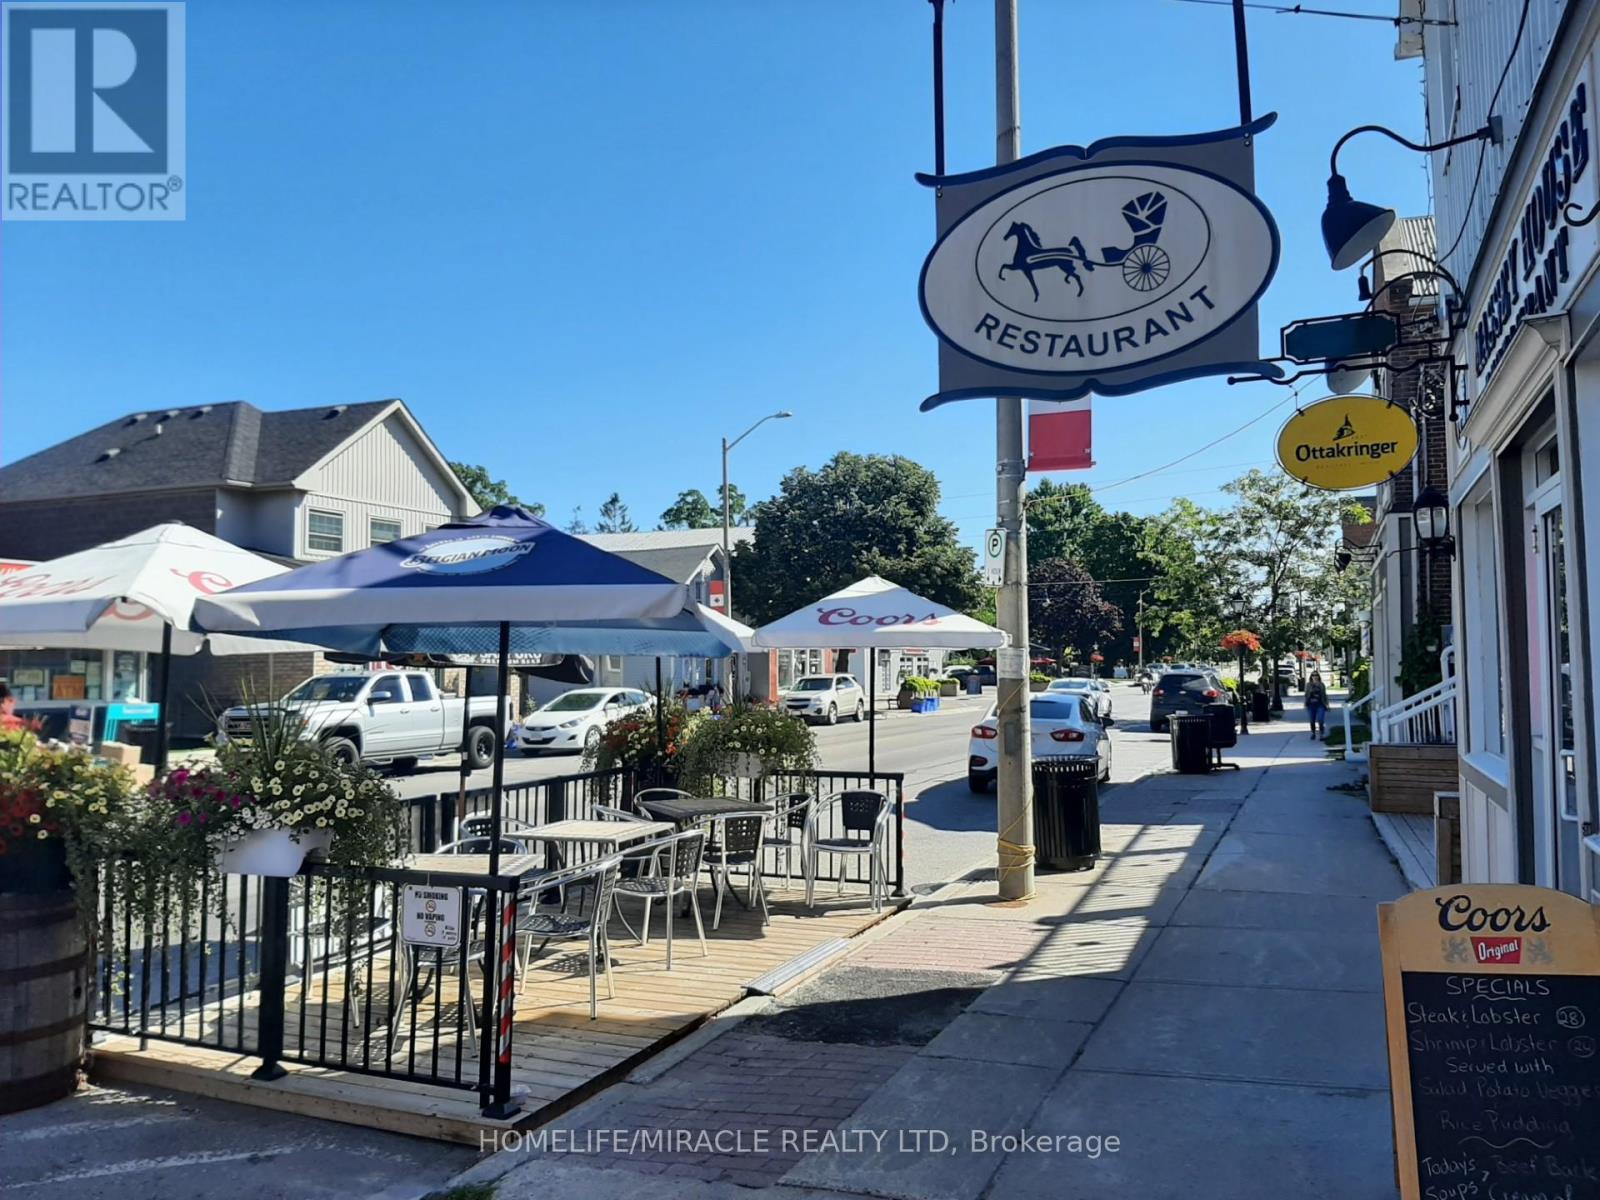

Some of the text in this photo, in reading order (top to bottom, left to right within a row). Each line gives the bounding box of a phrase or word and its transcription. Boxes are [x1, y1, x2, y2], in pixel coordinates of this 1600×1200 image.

[1521, 82, 1589, 282] HOUSE
[974, 285, 1216, 358] RESTAURANT
[1295, 441, 1398, 462] Ottakringer
[816, 607, 941, 626] Coors
[1435, 895, 1551, 932] Coors
[1478, 940, 1519, 960] Original
[1446, 976, 1550, 995] SPECIALS
[1407, 1002, 1460, 1024] Steak
[1471, 1005, 1541, 1025] Lobster
[1410, 1030, 1476, 1055] Shrimp
[1490, 1032, 1558, 1051] Lobster
[1446, 1057, 1554, 1075] Served with
[1476, 1076, 1530, 1098] Potato
[1440, 1110, 1482, 1132] Rice
[1425, 1181, 1479, 1200] Soups
